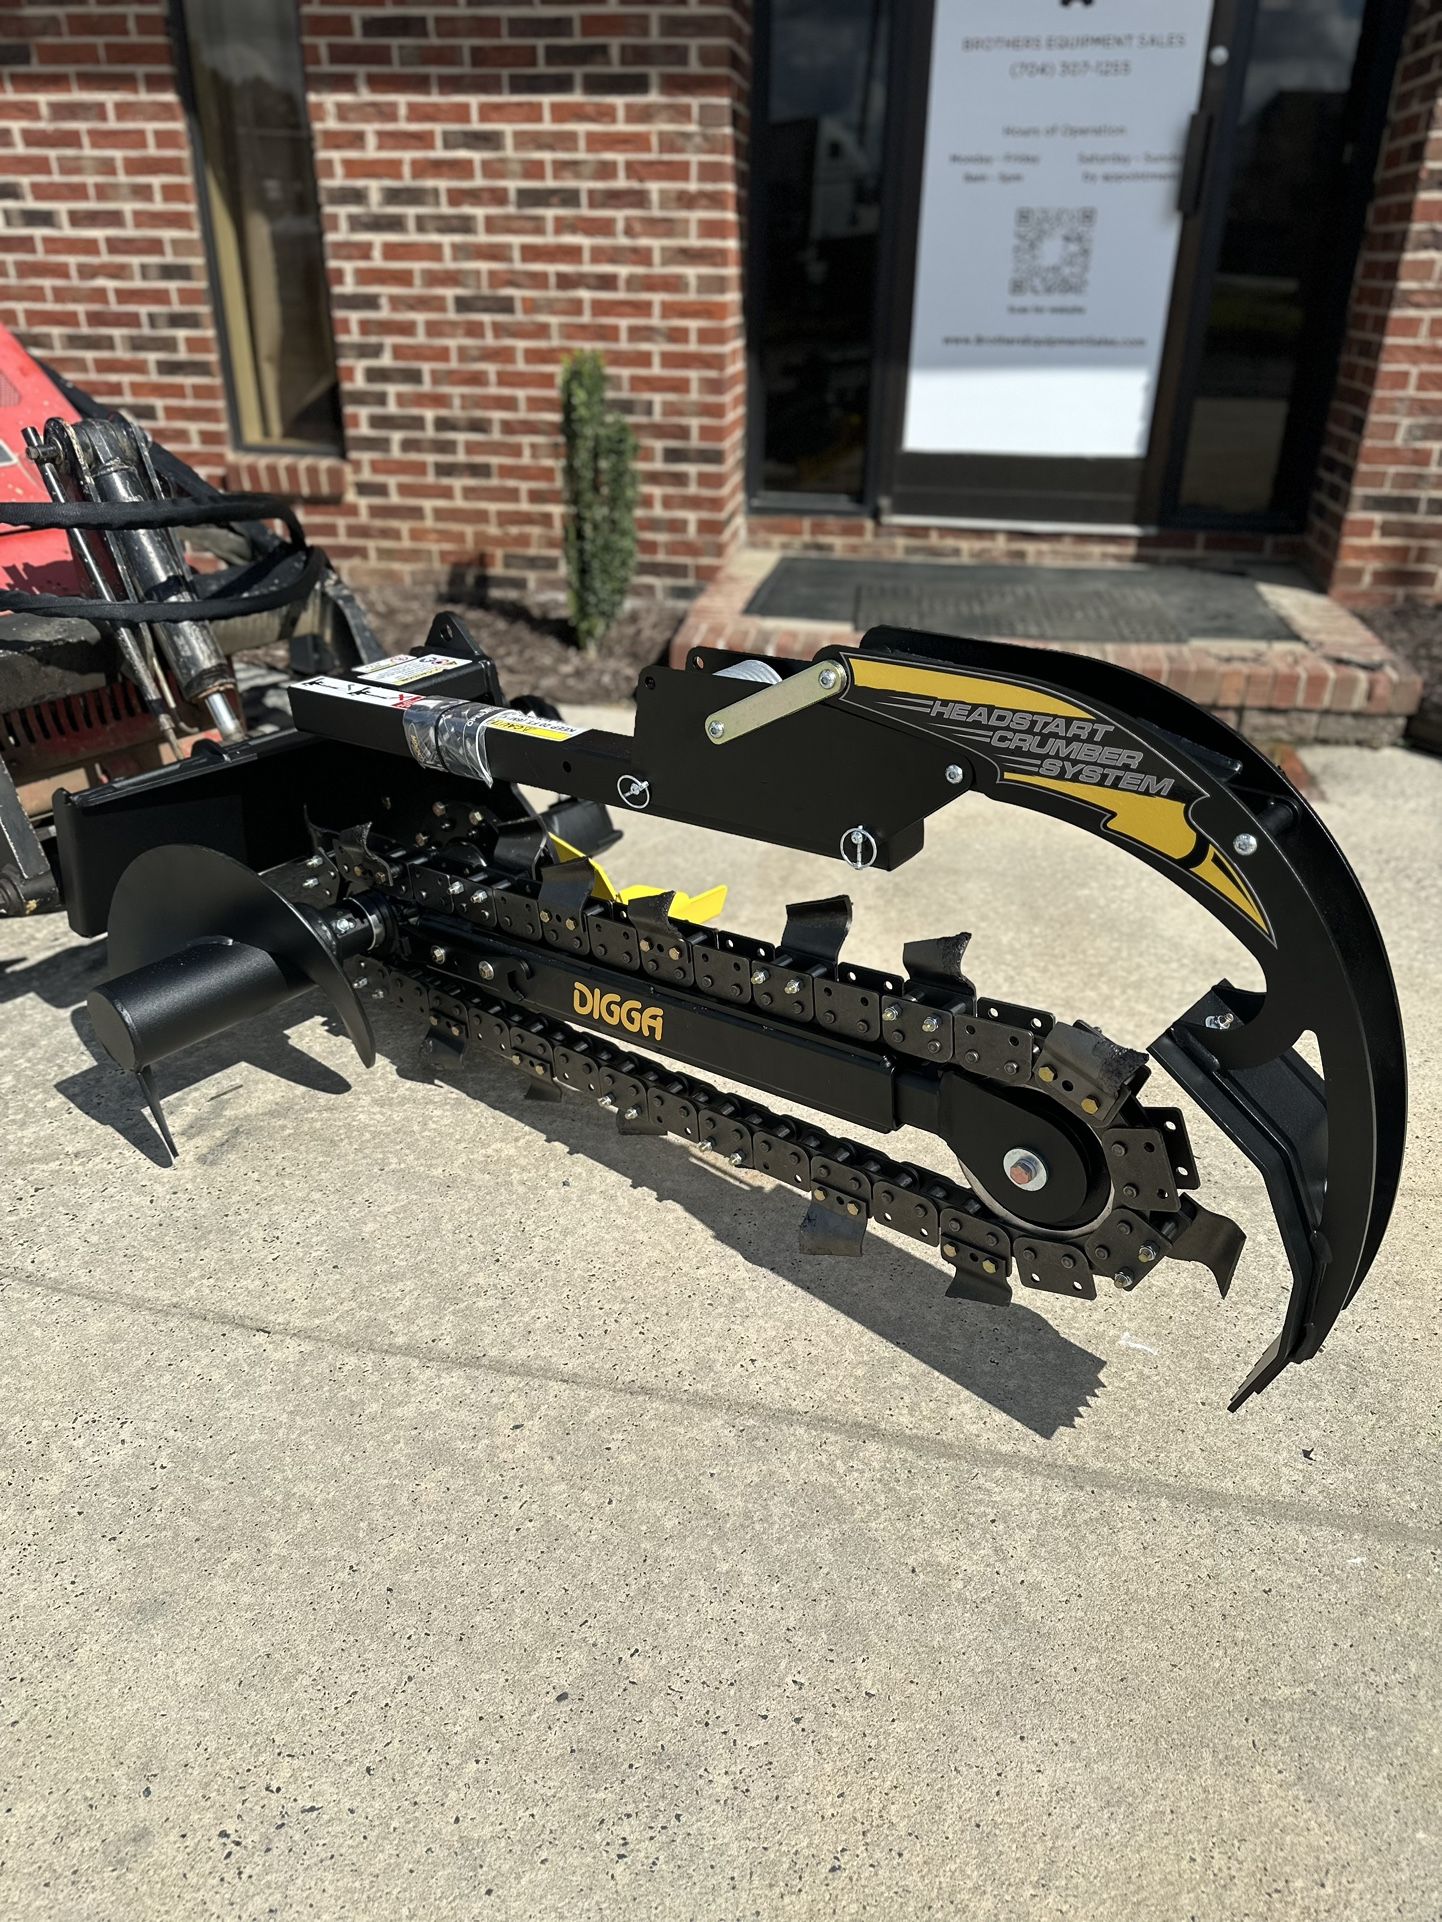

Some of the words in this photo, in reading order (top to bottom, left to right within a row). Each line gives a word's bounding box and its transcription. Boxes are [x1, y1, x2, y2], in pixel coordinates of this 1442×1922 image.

[962, 36, 1042, 52] BROTHERS
[1045, 34, 1133, 51] EQUIPMENT
[1137, 33, 1187, 49] SALES
[1010, 60, 1056, 78] (704)
[1003, 124, 1040, 137] Hours
[1043, 123, 1057, 137] of
[1060, 123, 1126, 139] Operation
[930, 700, 1115, 743] HEADSTART
[990, 730, 1143, 769] CRUMBER
[1038, 757, 1175, 796] SYSTEM
[573, 981, 664, 1041] DIGGA
